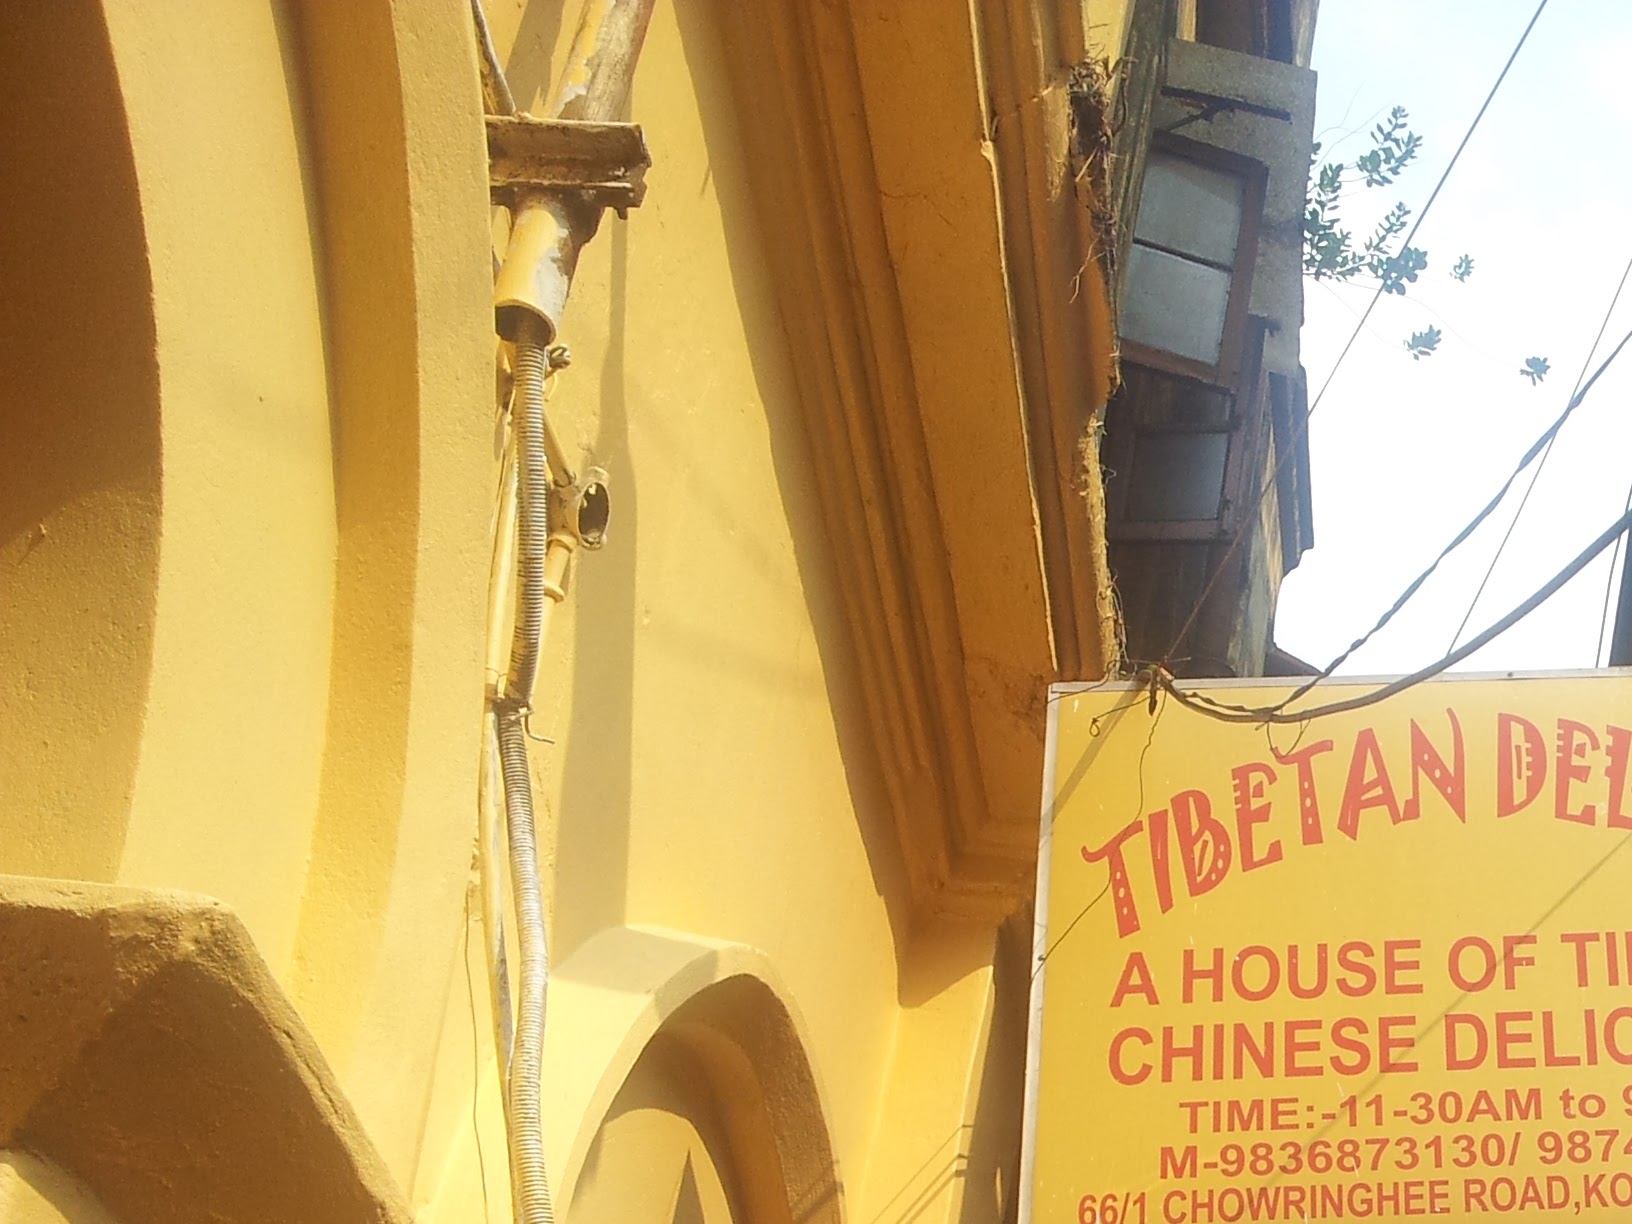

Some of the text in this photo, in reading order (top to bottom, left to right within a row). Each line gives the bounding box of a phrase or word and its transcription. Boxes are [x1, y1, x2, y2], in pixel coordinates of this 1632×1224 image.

[1081, 706, 1466, 939] TIBETAN
[1111, 951, 1161, 1009] A
[1182, 939, 1424, 1005] HOUSE
[1448, 935, 1538, 993] OF
[1108, 1015, 1420, 1087] CHINESE
[1179, 1087, 1543, 1134] TIME:-11-30AM
[1560, 1088, 1606, 1119] to
[1159, 1131, 1520, 1180] M-9836873130/
